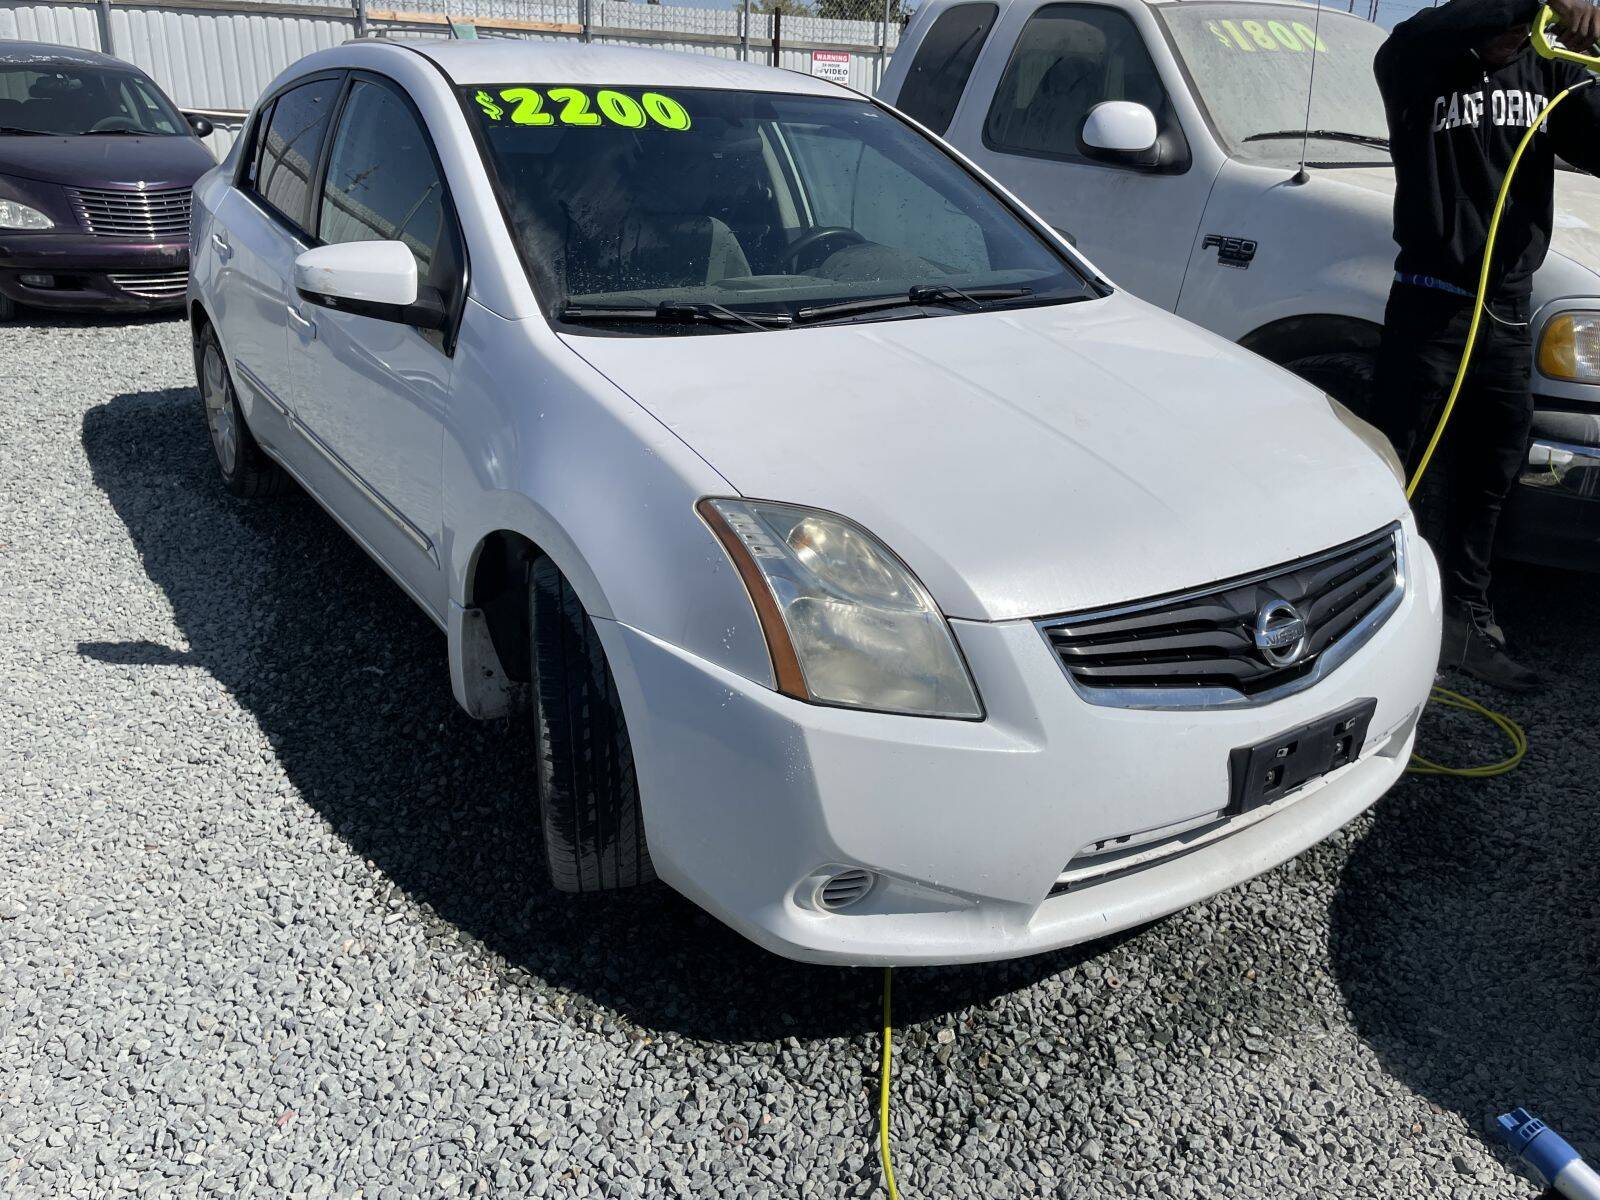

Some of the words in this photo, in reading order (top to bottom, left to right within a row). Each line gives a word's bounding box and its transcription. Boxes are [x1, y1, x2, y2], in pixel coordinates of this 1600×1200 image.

[1206, 19, 1328, 52] $1800
[816, 53, 848, 61] WARNING
[475, 86, 692, 131] $2200
